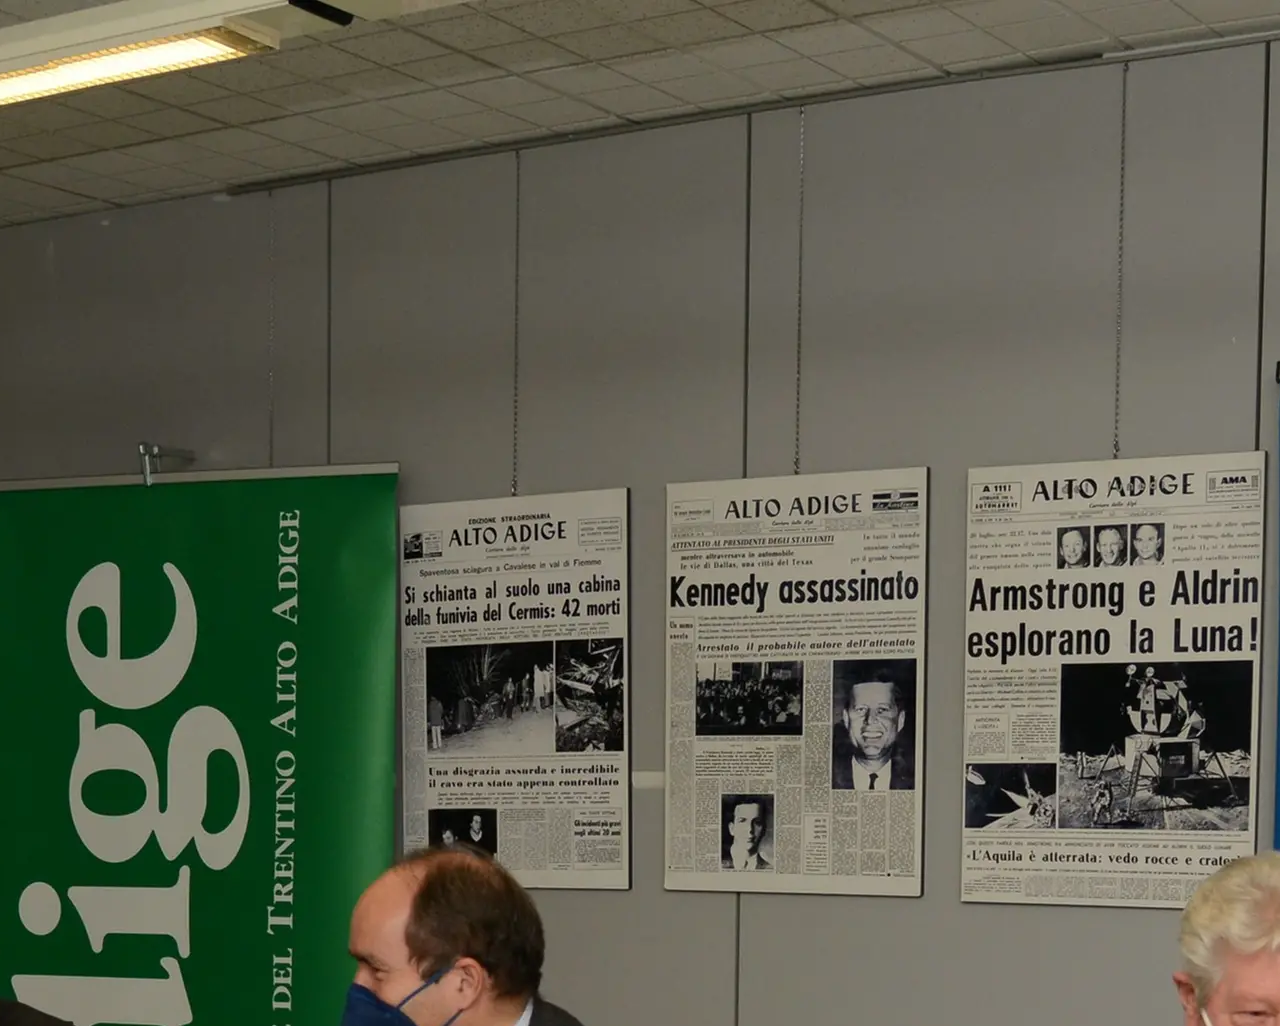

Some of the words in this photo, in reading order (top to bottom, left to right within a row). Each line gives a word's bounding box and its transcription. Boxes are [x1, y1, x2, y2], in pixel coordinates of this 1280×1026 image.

[1032, 479, 1097, 501] ALTO
[1108, 473, 1194, 498] ADIGE
[1221, 476, 1247, 484] AMA
[501, 513, 551, 522] STRAORDINARIA
[725, 499, 781, 519] ALTO
[789, 494, 862, 515] ADIGE
[449, 527, 497, 547] ALTO
[504, 521, 567, 543] ADIGE
[672, 541, 711, 549] ATTENTATO
[723, 538, 765, 546] PRESIDENTE
[272, 510, 300, 625] ADIGE
[420, 569, 459, 577] Spaventosa
[463, 566, 492, 576] sciagura
[504, 562, 536, 571] Cavalese
[405, 586, 415, 604] Si
[423, 582, 476, 603] schianta
[486, 581, 496, 598] al
[506, 578, 539, 597] suolo
[548, 579, 571, 594] una
[579, 574, 620, 593] cabina
[670, 574, 768, 613] Kennedy
[779, 569, 919, 603] assassinato
[969, 578, 1124, 616] Armstrong
[1139, 580, 1155, 607] e
[1171, 569, 1258, 605] Aldrin
[405, 608, 431, 626] della
[436, 607, 477, 624] funivia
[483, 604, 501, 622] del
[509, 602, 555, 620] Cermis:
[562, 599, 580, 617] 42
[587, 598, 620, 616] morti
[696, 644, 739, 652] Arrestato
[747, 642, 756, 650] il
[758, 641, 806, 652] probabile
[810, 641, 843, 650] autore
[847, 638, 915, 648] dell'attentato
[968, 623, 1110, 664] esplorano
[1130, 620, 1154, 654] la
[1174, 617, 1257, 653] Luna!
[270, 641, 298, 737] ALTO
[429, 767, 449, 776] Una
[453, 767, 500, 777] disgrazia
[505, 766, 547, 775] assurda
[561, 765, 619, 774] incredibile
[429, 779, 436, 787] il
[488, 779, 512, 787] stato
[517, 779, 554, 789] appena
[559, 776, 619, 786] controllato
[267, 751, 297, 935] TRENTINO
[1029, 849, 1036, 861] è
[1042, 850, 1102, 864] atterrata:
[1108, 852, 1139, 864] vedo
[1145, 854, 1179, 865] rocce
[1186, 856, 1192, 864] e
[1199, 855, 1243, 866] crate
[272, 948, 293, 1011] DEL
